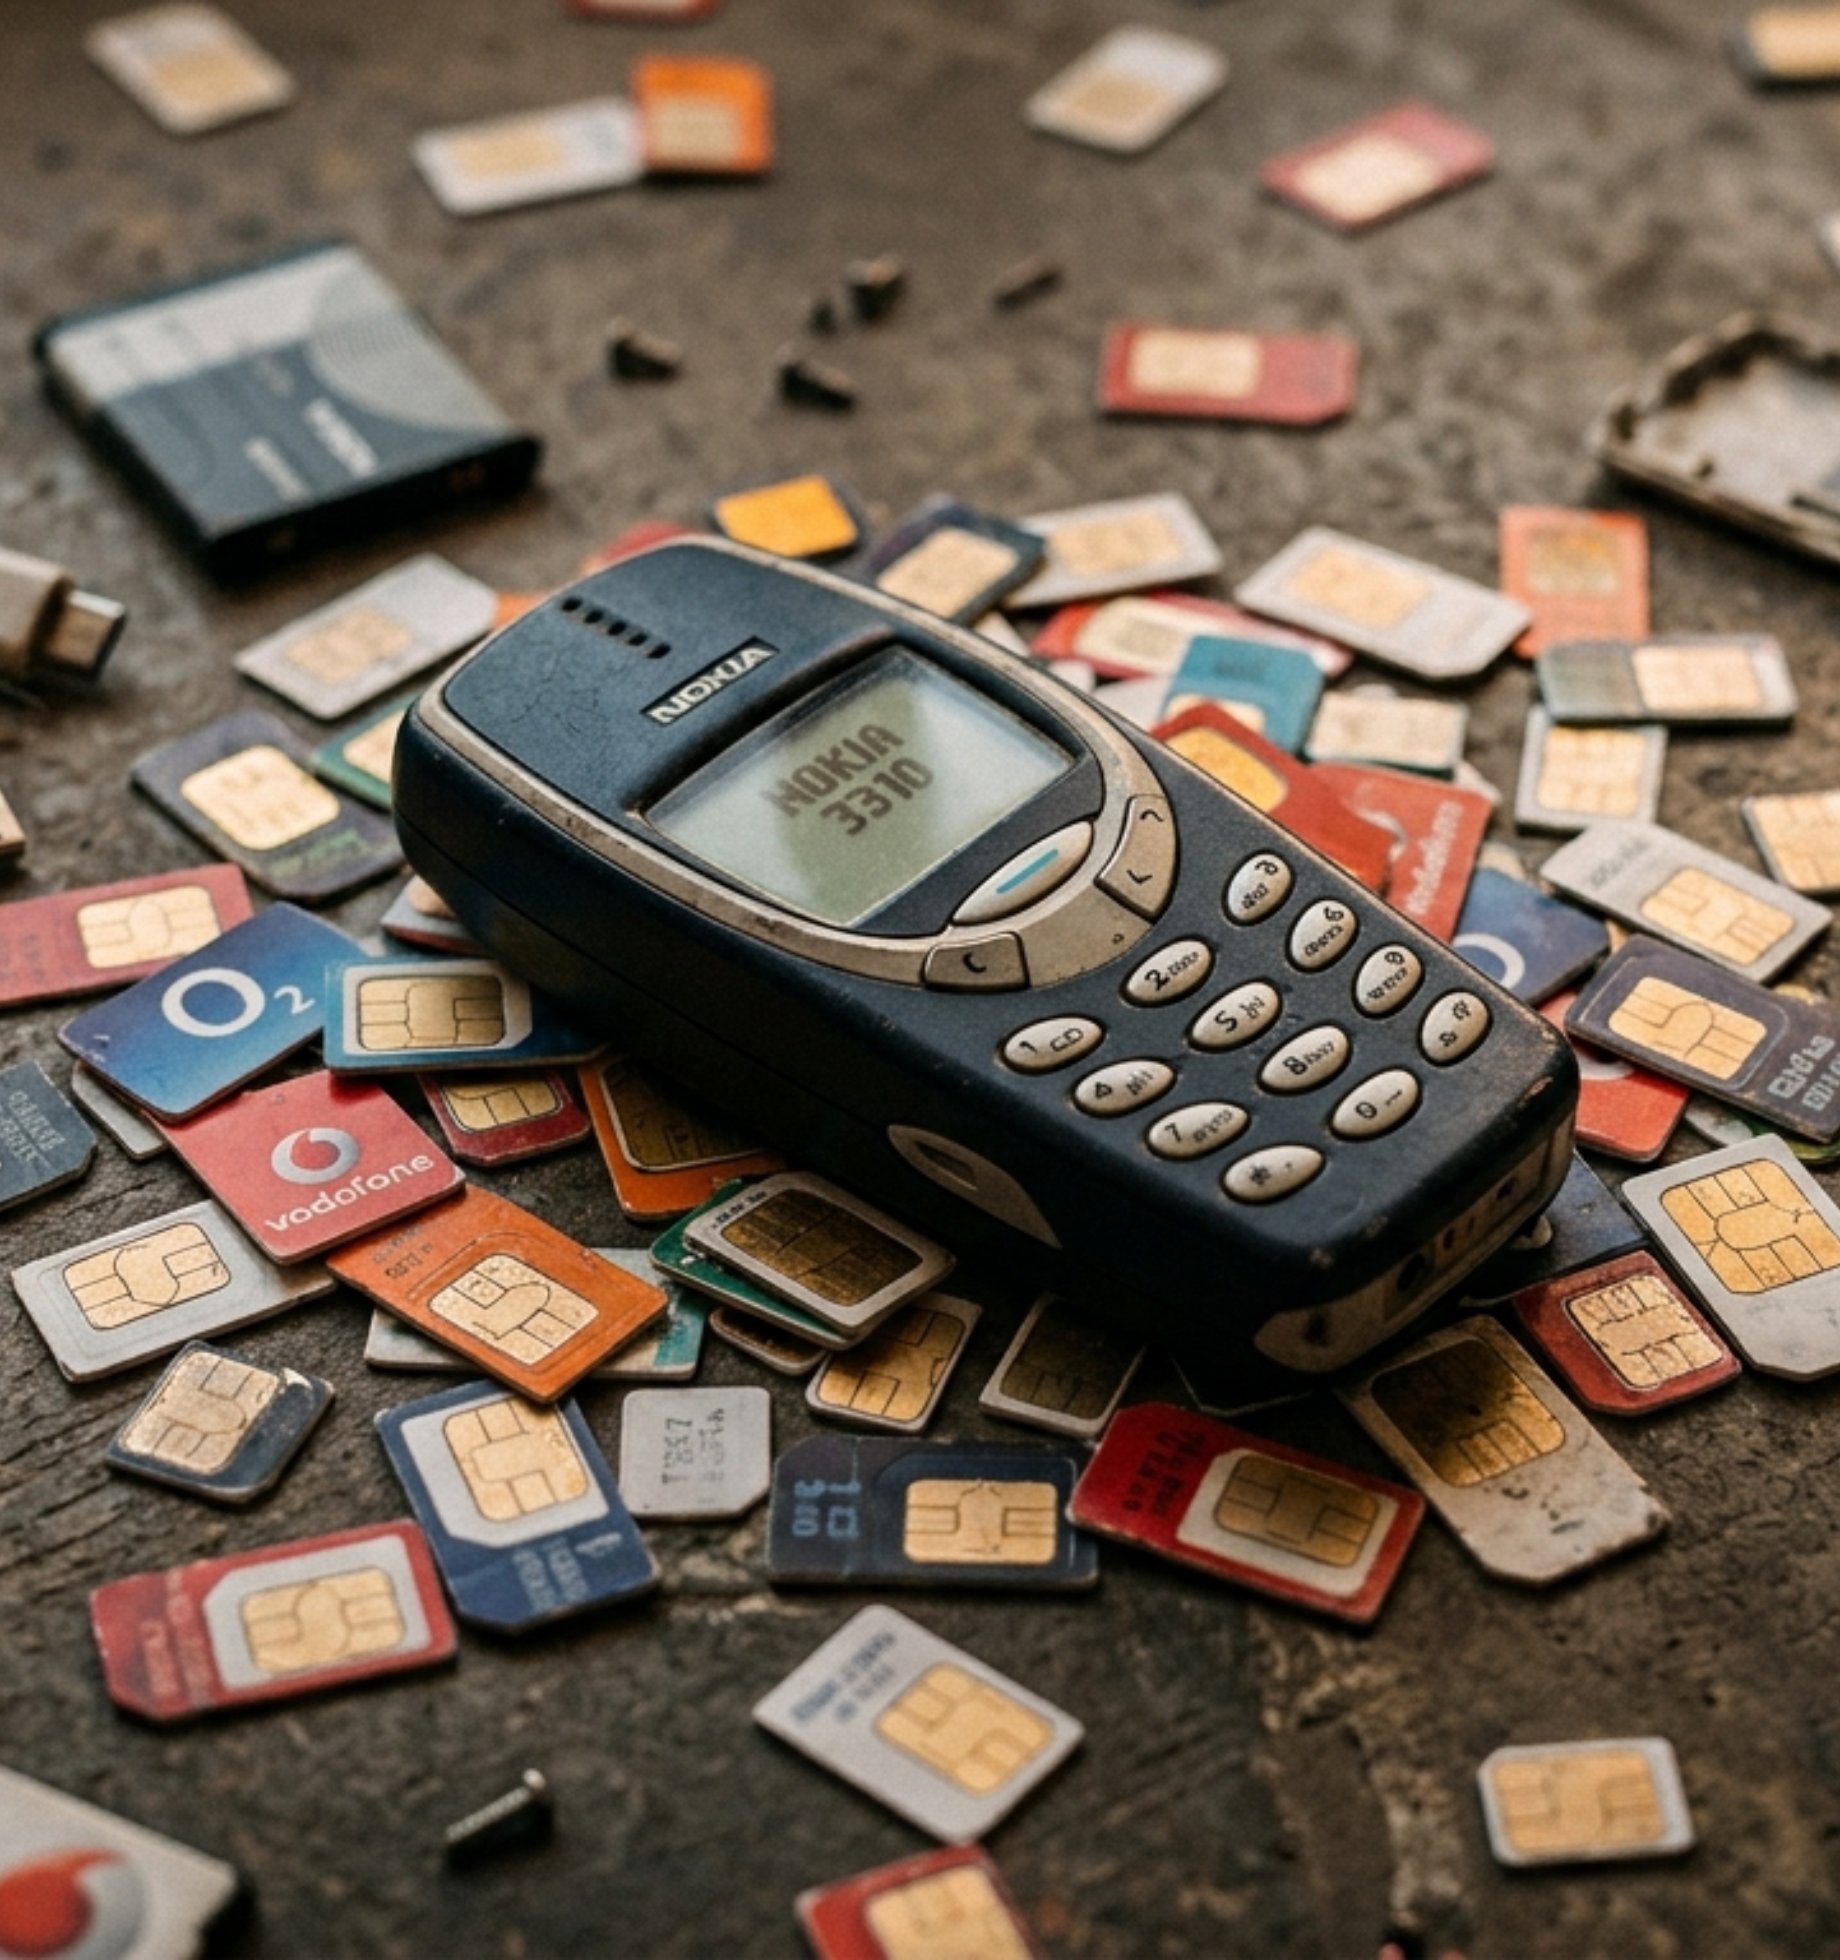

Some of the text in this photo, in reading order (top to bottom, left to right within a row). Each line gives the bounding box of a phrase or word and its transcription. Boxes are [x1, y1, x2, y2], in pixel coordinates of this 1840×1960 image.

[648, 645, 772, 725] NOKIA
[762, 722, 905, 818] NOKIA
[820, 757, 935, 837] 3310
[161, 967, 315, 1038] O2
